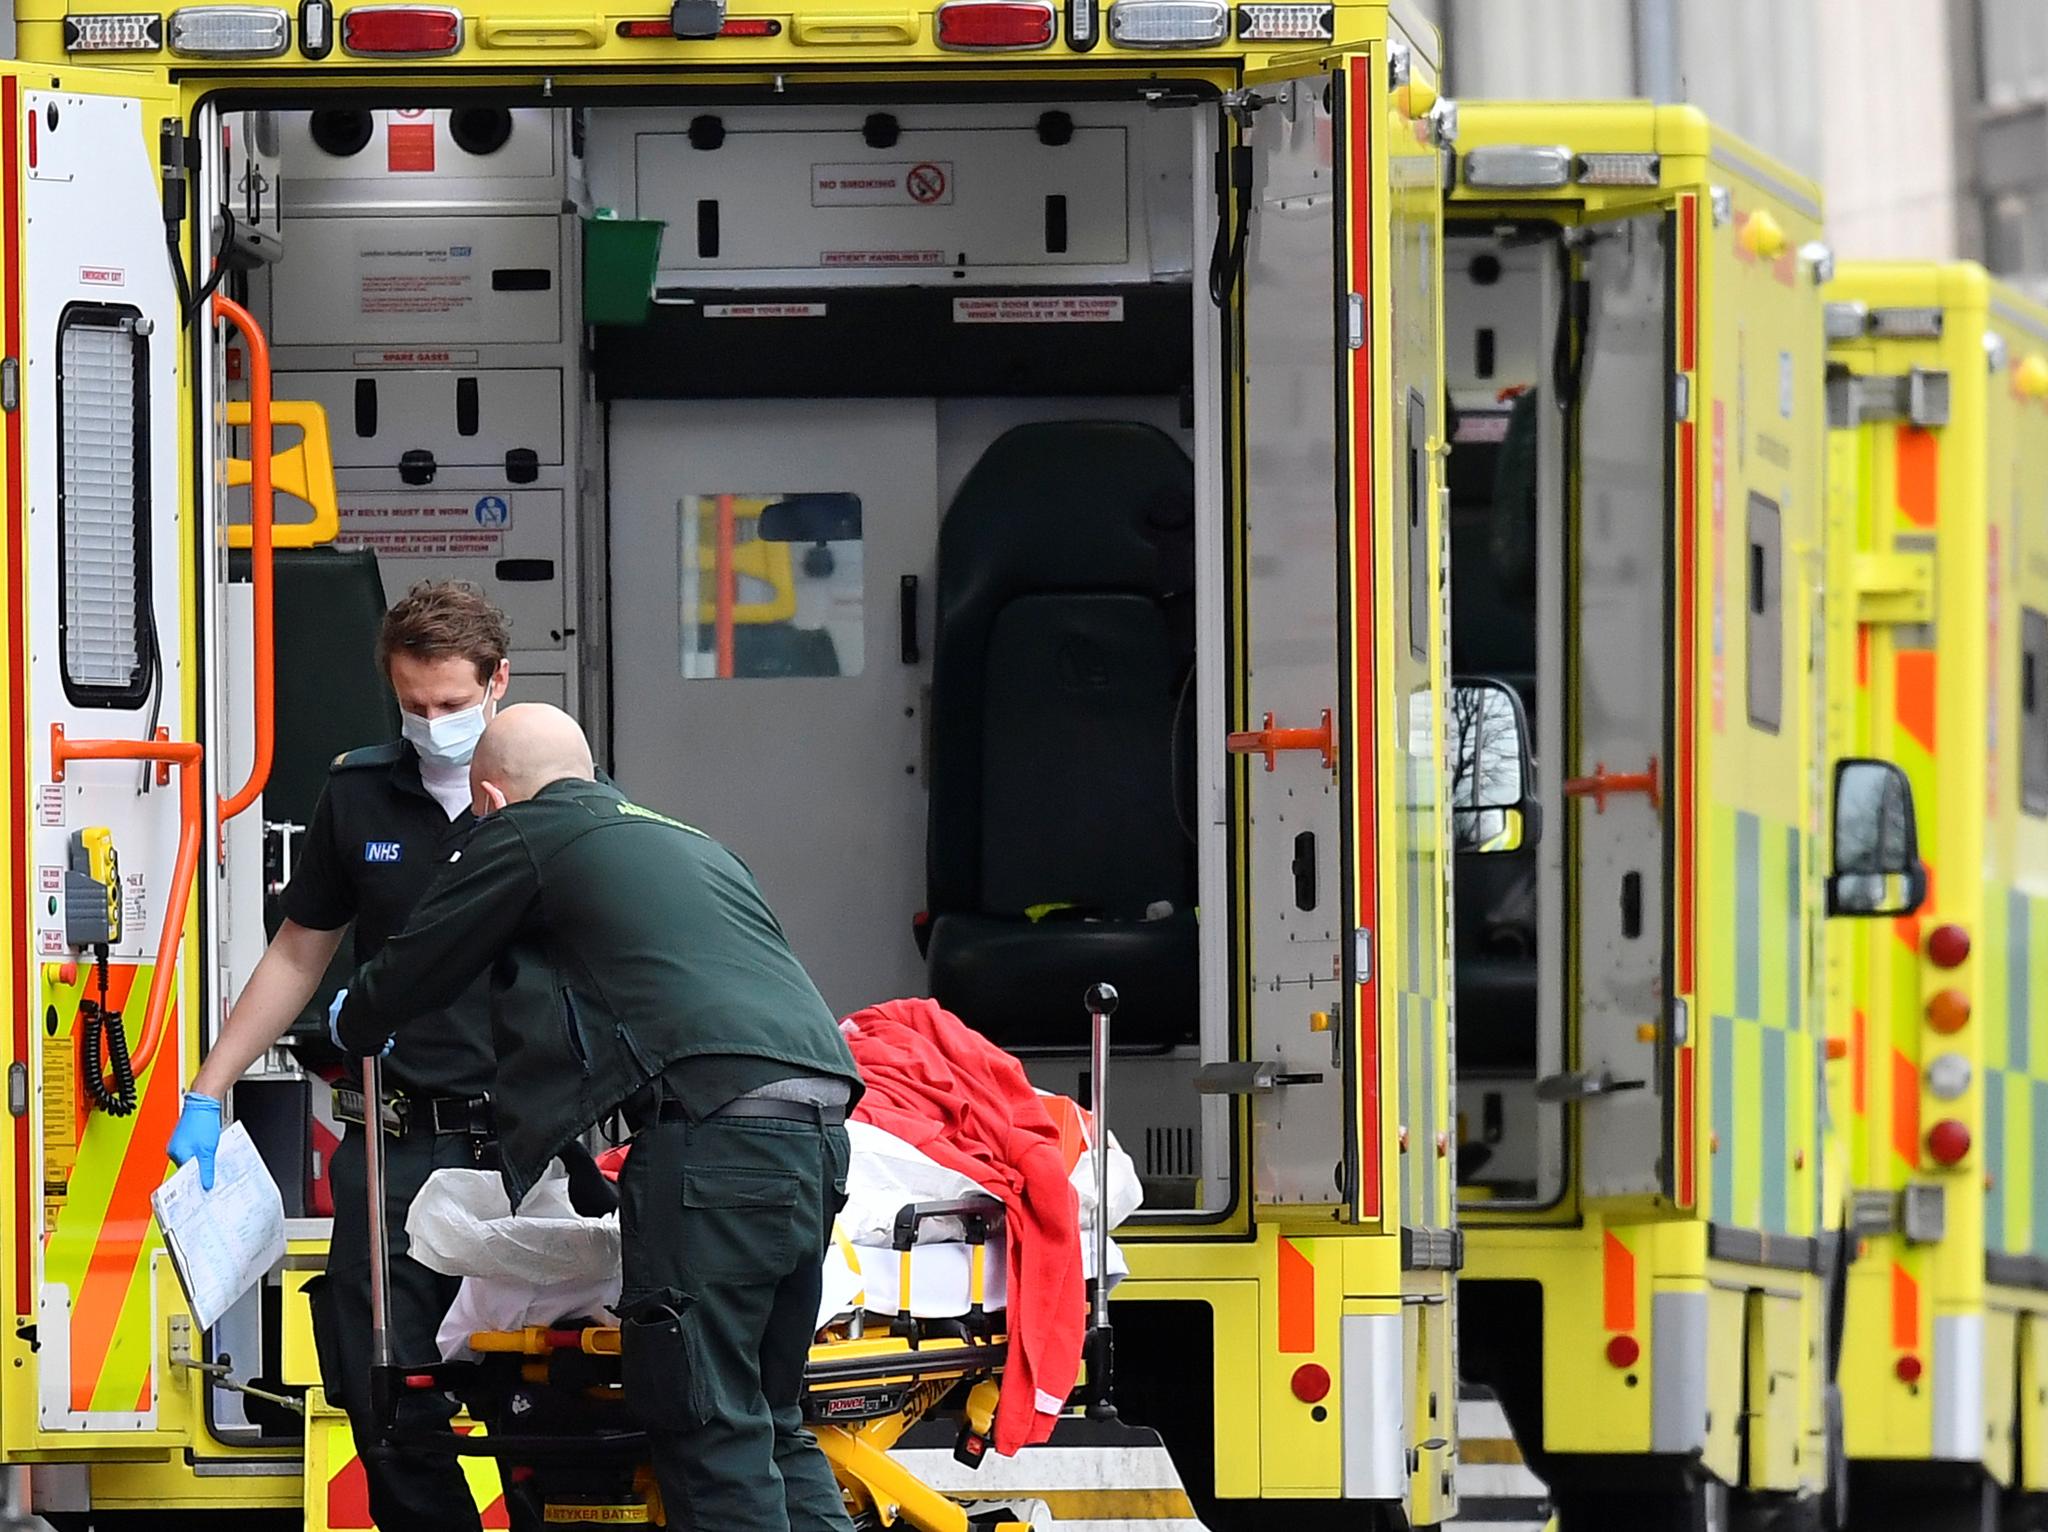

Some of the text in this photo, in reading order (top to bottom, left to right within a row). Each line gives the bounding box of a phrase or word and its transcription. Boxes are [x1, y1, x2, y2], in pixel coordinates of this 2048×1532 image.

[819, 180, 896, 189] NO SMOKING
[337, 507, 469, 517] EAT BELTS MUST BE WORN
[362, 535, 391, 544] MUST
[410, 534, 447, 544] FACING
[450, 534, 498, 543] FORWARD
[378, 545, 420, 553] VEHICLE
[449, 544, 489, 553] MOTION
[368, 843, 401, 860] NHS
